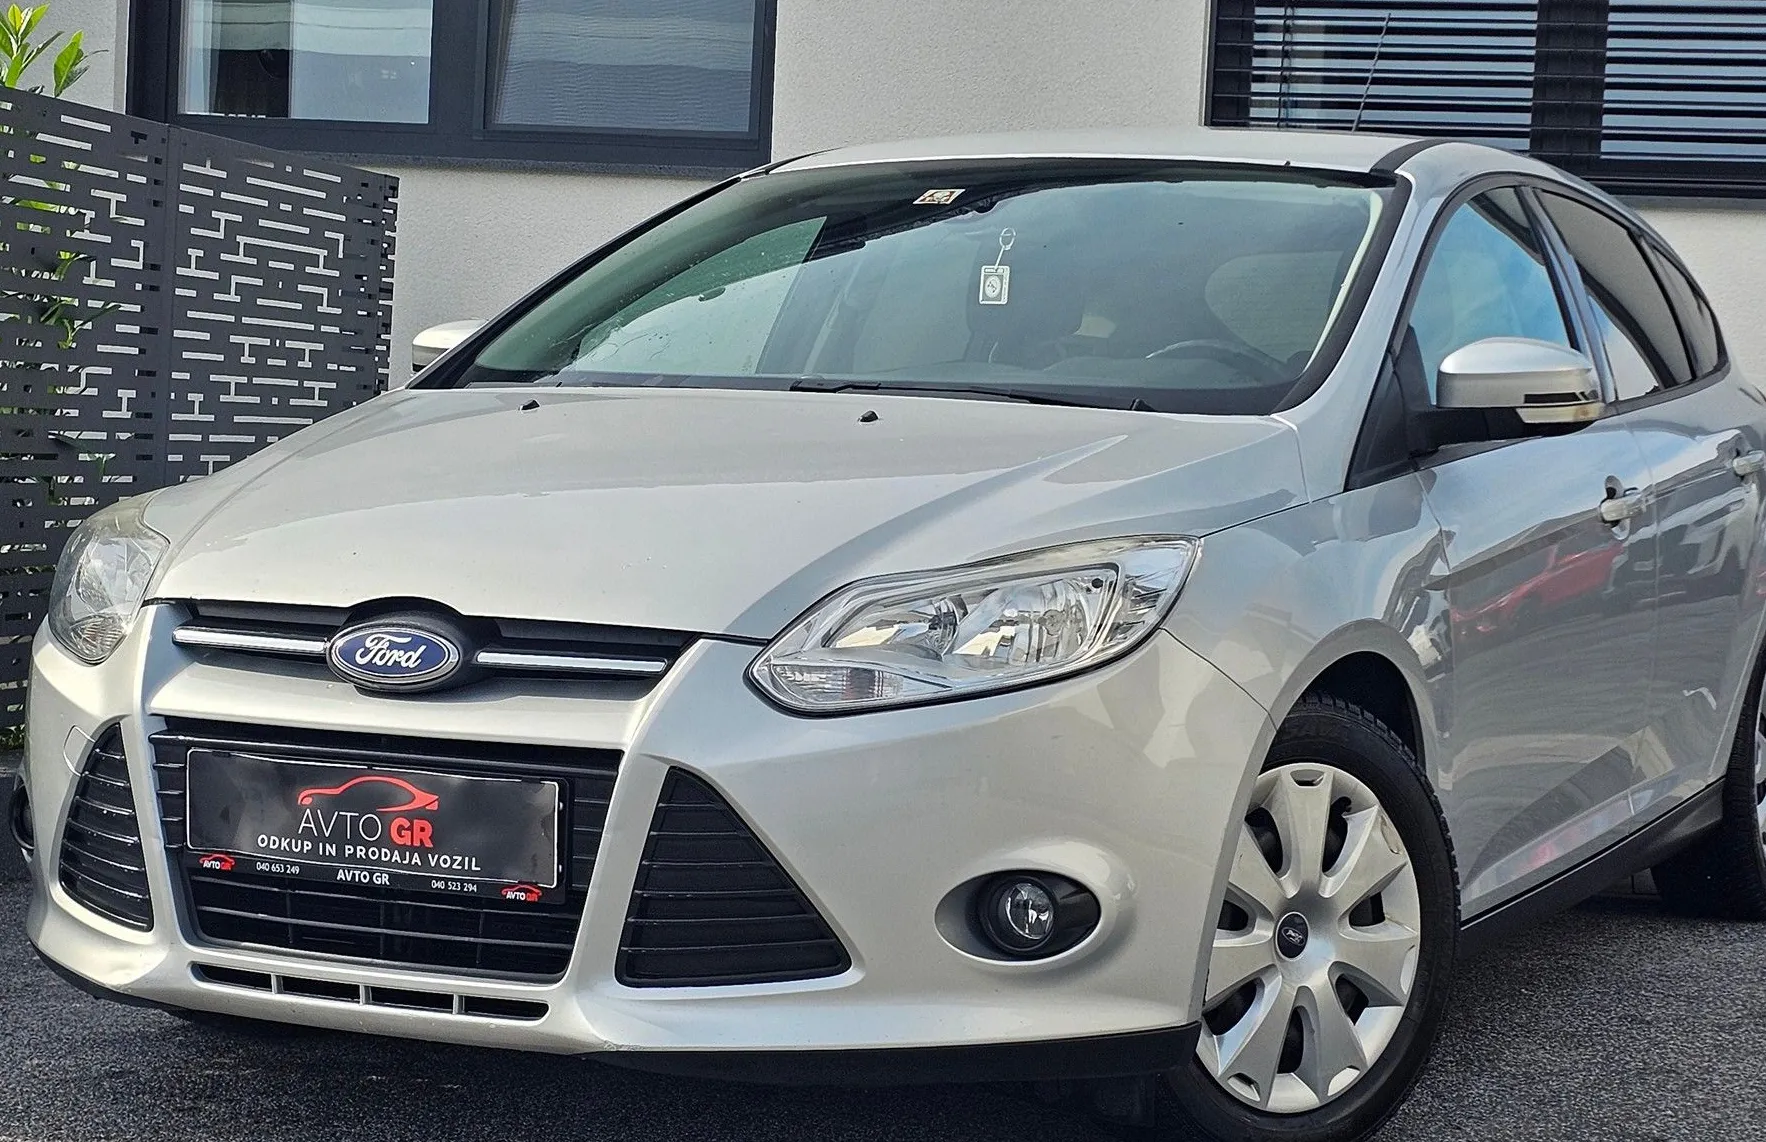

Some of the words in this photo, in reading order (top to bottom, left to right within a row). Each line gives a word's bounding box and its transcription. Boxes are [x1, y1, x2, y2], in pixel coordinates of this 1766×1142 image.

[355, 633, 427, 668] Ford
[297, 808, 382, 842] AVTO
[390, 816, 433, 848] GR
[257, 834, 312, 854] ODKUP
[319, 842, 337, 857] IN
[345, 844, 422, 866] PRODAJA
[428, 853, 481, 871] VOZIL
[203, 859, 221, 869] AVTO
[256, 861, 270, 871] 040
[271, 863, 285, 873] 653
[286, 864, 300, 875] 249
[336, 869, 370, 883] AVTO
[372, 873, 390, 886] GR
[431, 879, 445, 890] 040
[447, 881, 461, 891] 523
[463, 883, 477, 893] 294
[506, 891, 526, 901] AVTO
